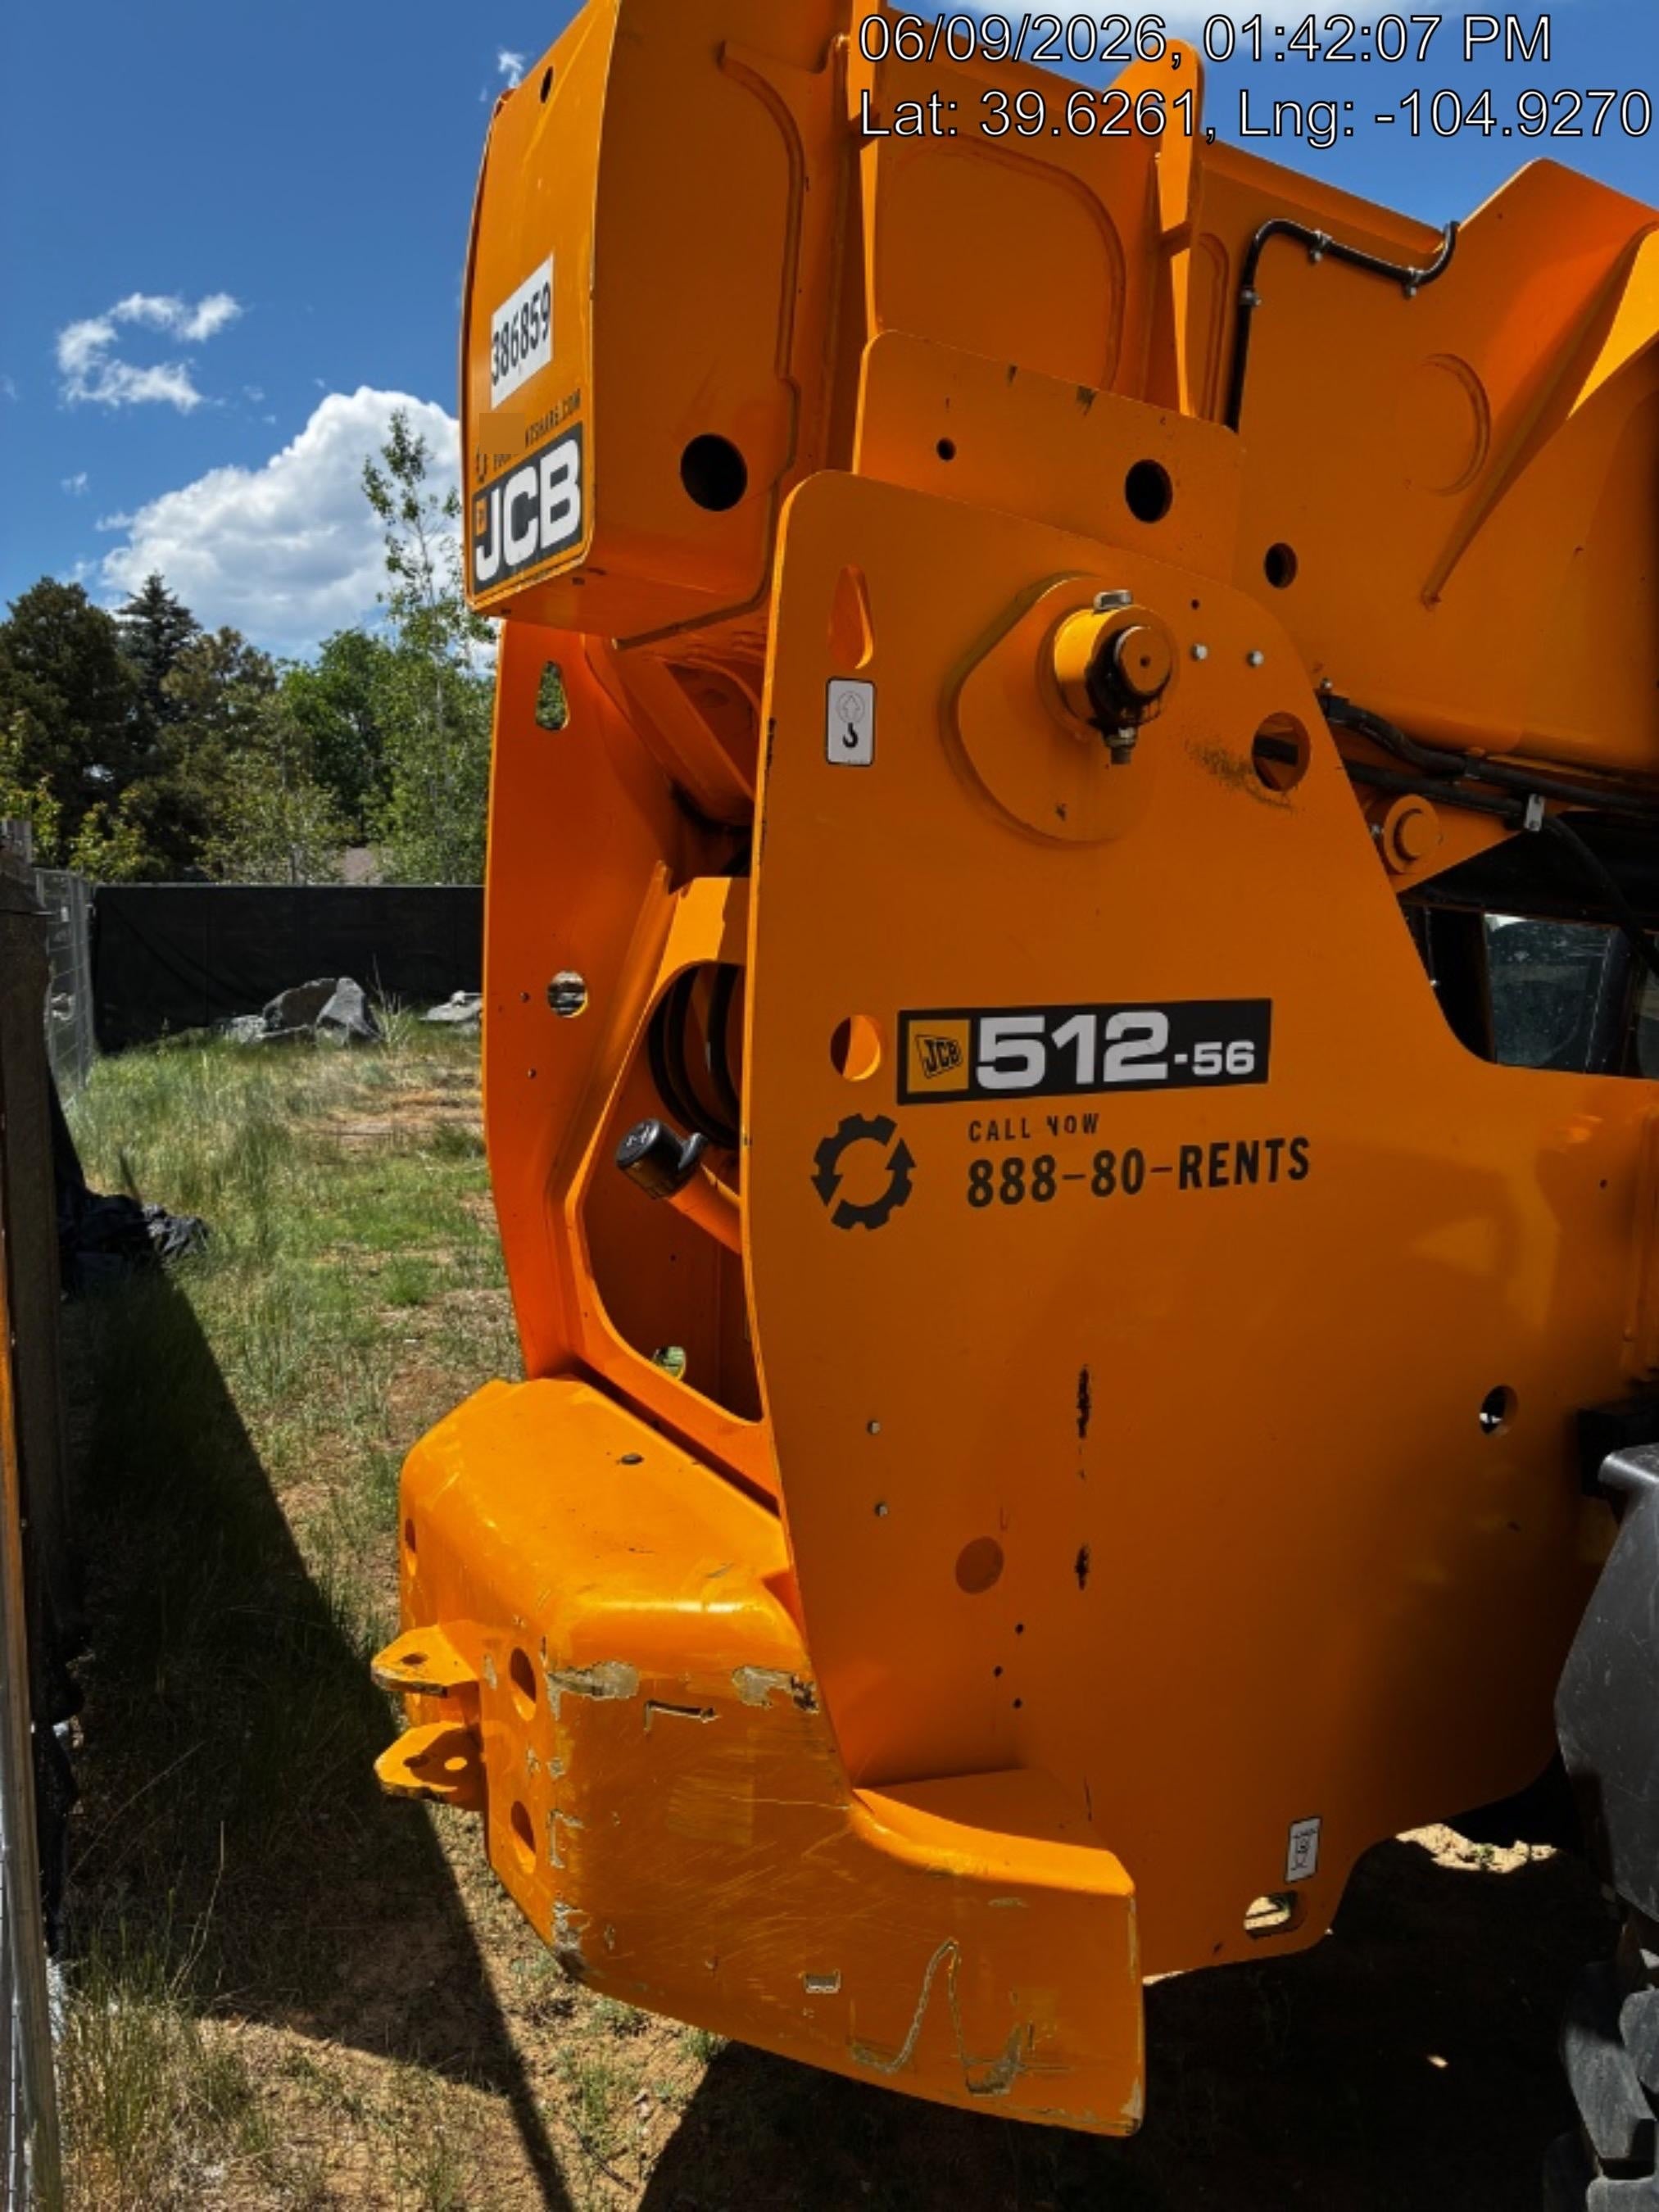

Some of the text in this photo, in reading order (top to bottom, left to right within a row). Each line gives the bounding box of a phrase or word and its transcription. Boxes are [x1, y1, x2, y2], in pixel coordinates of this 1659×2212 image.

[492, 281, 551, 387] 386859
[476, 437, 581, 581] JCB
[921, 1037, 962, 1075] JCB
[976, 1011, 1256, 1090] 512-56
[968, 1117, 1031, 1142] CALL
[968, 1136, 1310, 1208] 888-80-RENTS
